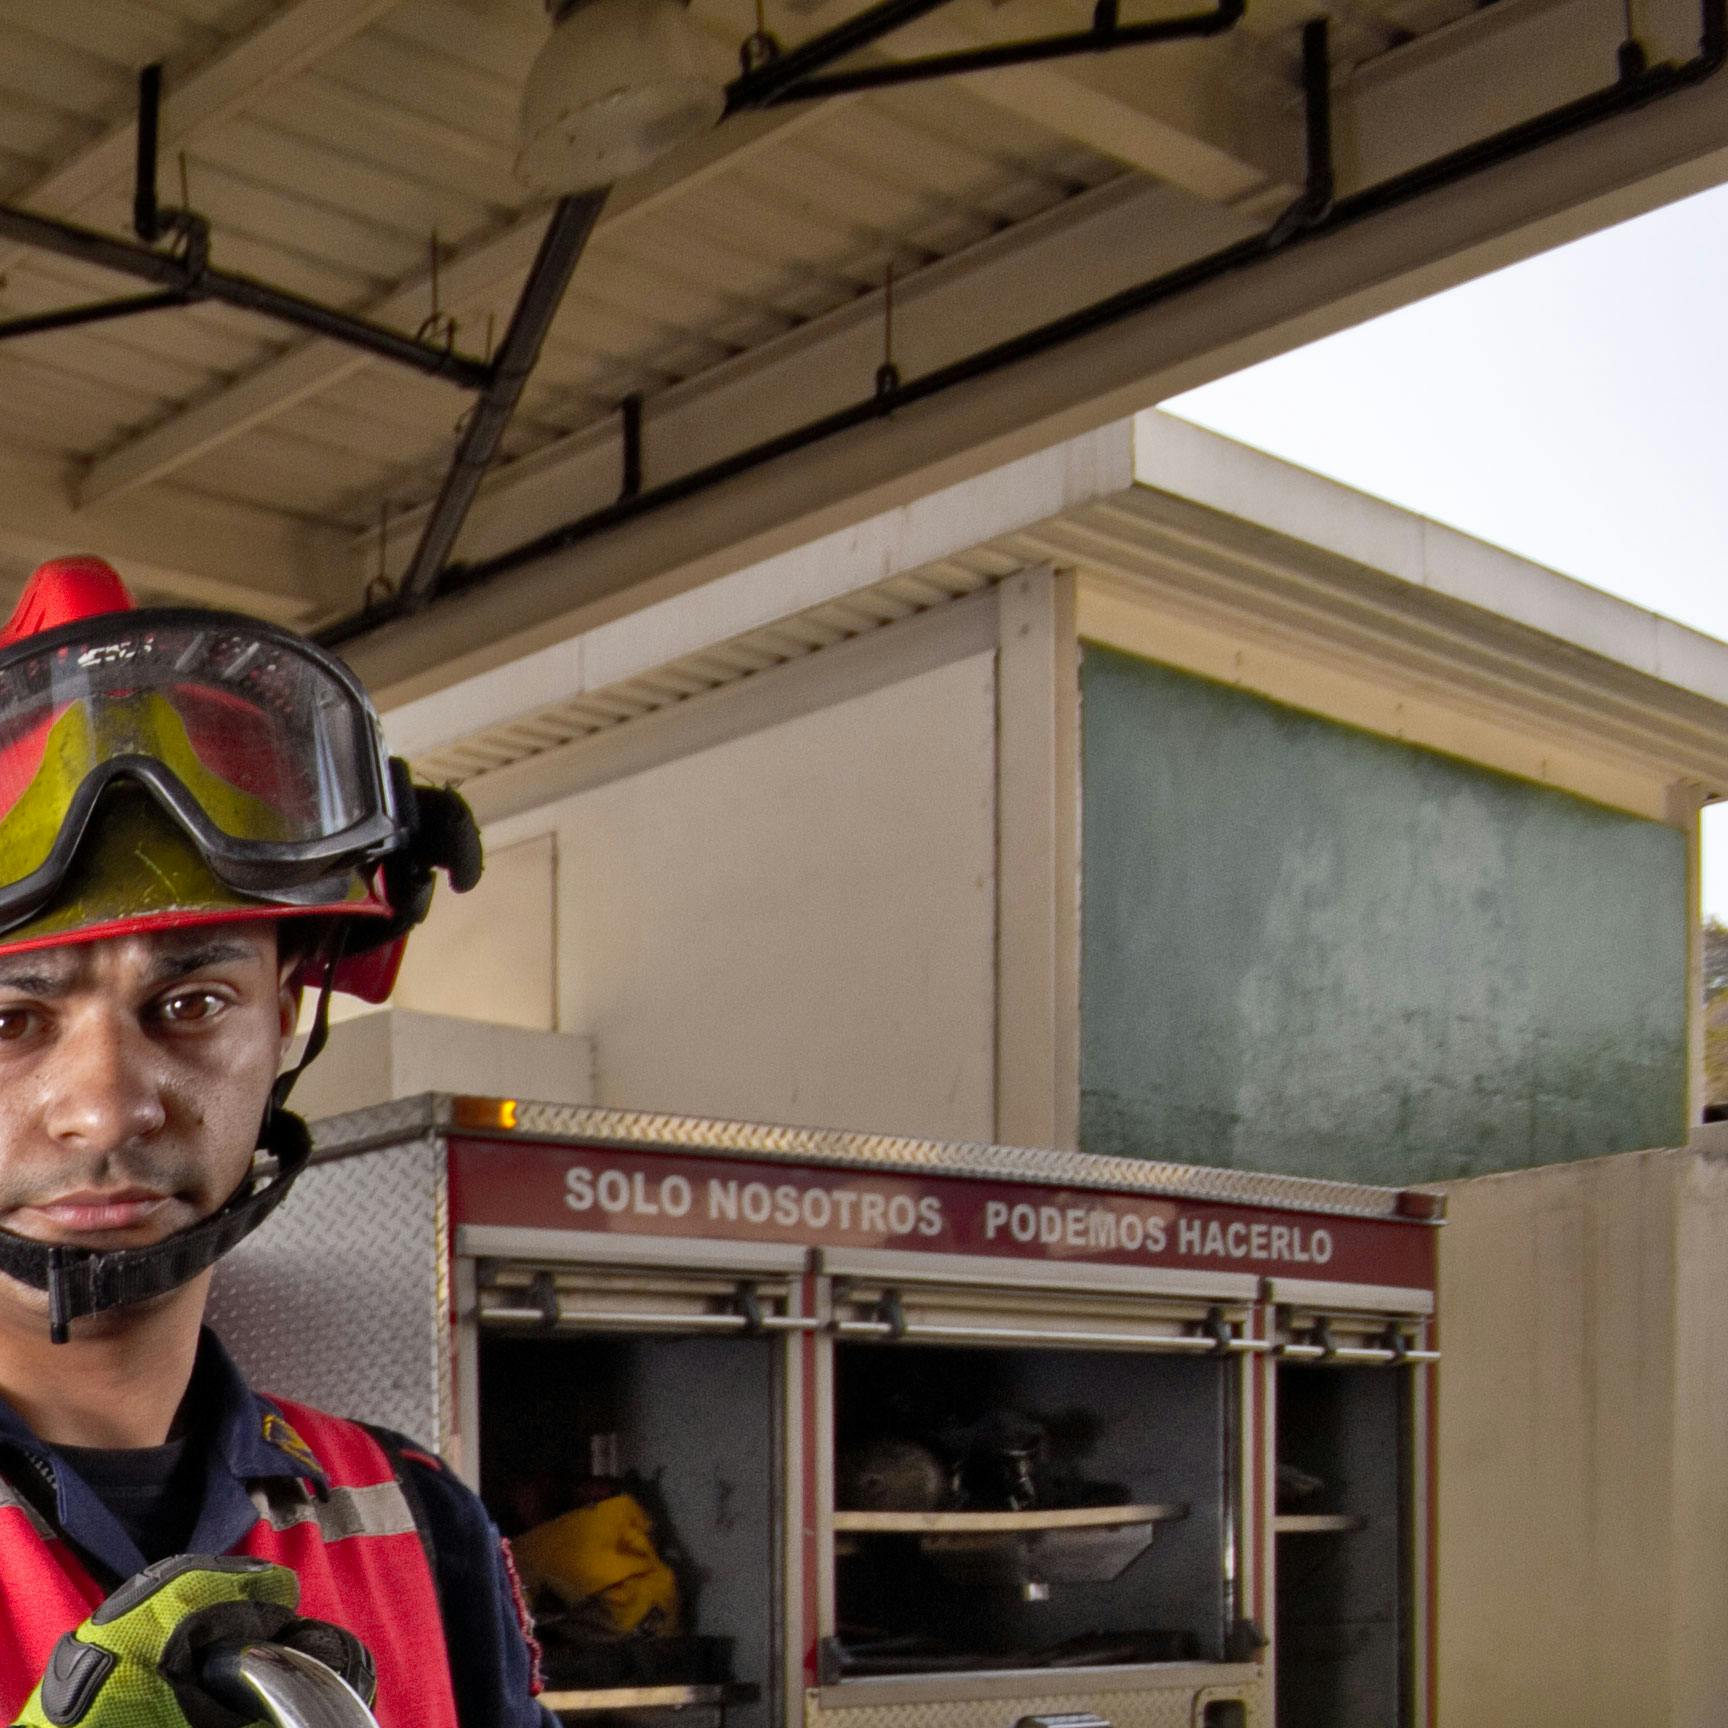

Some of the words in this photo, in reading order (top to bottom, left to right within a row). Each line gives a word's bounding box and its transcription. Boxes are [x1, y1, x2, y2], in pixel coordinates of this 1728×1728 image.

[564, 1166, 693, 1217] SOLO
[707, 1178, 943, 1237] NOSOTROS
[985, 1201, 1167, 1253] PODEMOS
[1178, 1218, 1333, 1265] HACERLO
